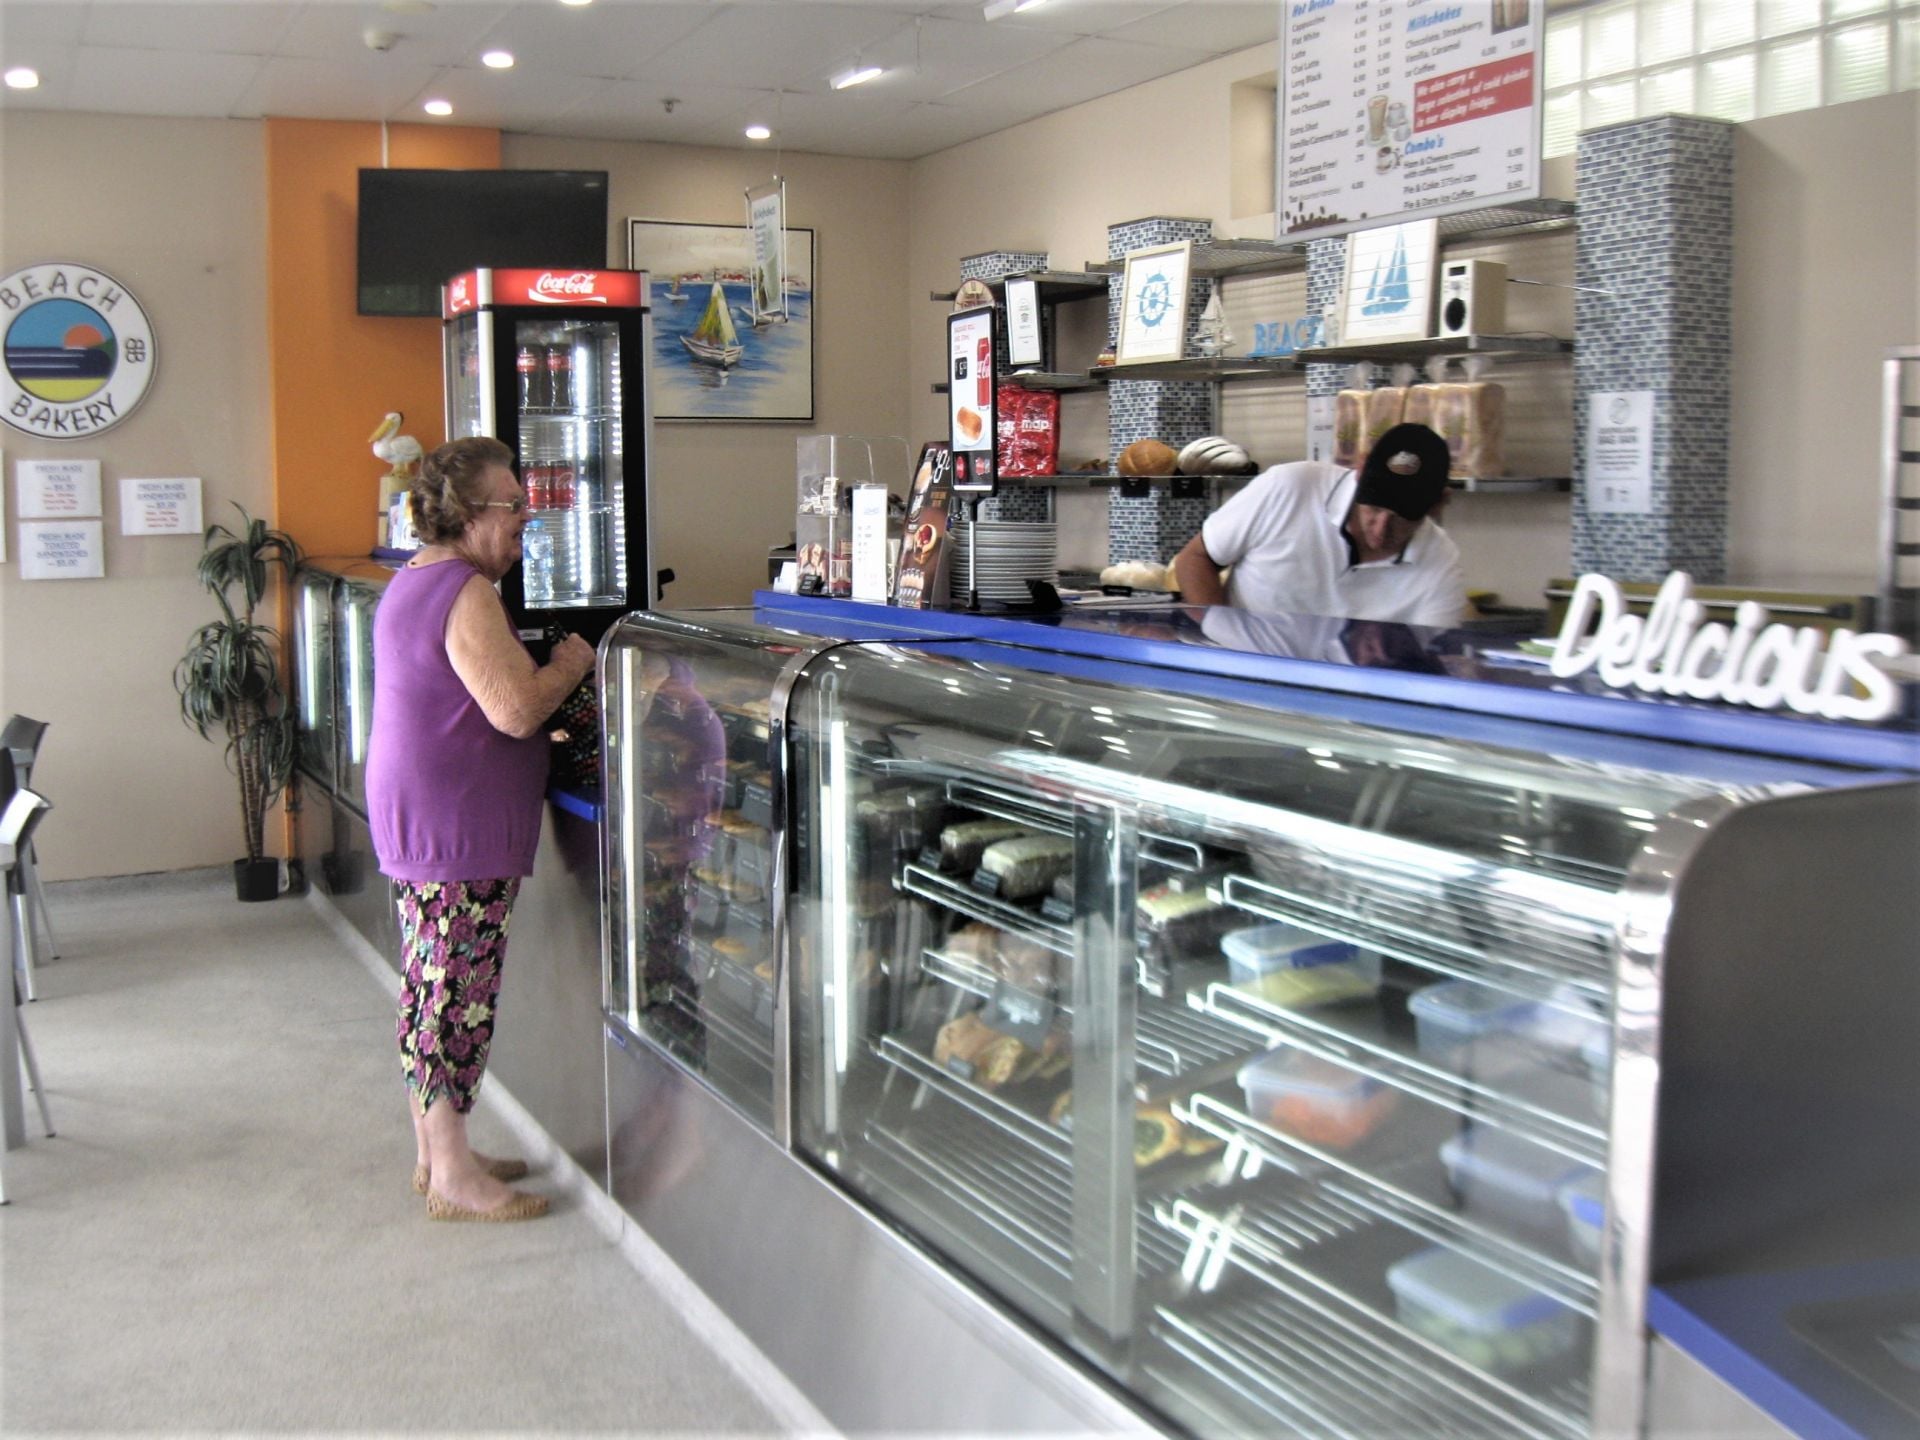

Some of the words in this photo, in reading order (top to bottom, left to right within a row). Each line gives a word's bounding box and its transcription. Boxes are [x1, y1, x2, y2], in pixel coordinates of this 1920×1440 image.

[1407, 7, 1462, 32] Milkshakes
[1413, 63, 1436, 76] Coffee
[1302, 99, 1331, 113] Chocolate
[1404, 133, 1445, 156] Combo's
[1403, 185, 1414, 195] Pie
[1403, 201, 1414, 209] Pie
[0, 271, 121, 312] BEACH
[536, 273, 598, 295] Coca-Cola
[10, 392, 118, 434] BAKERY
[1549, 570, 1907, 722] Delicious
